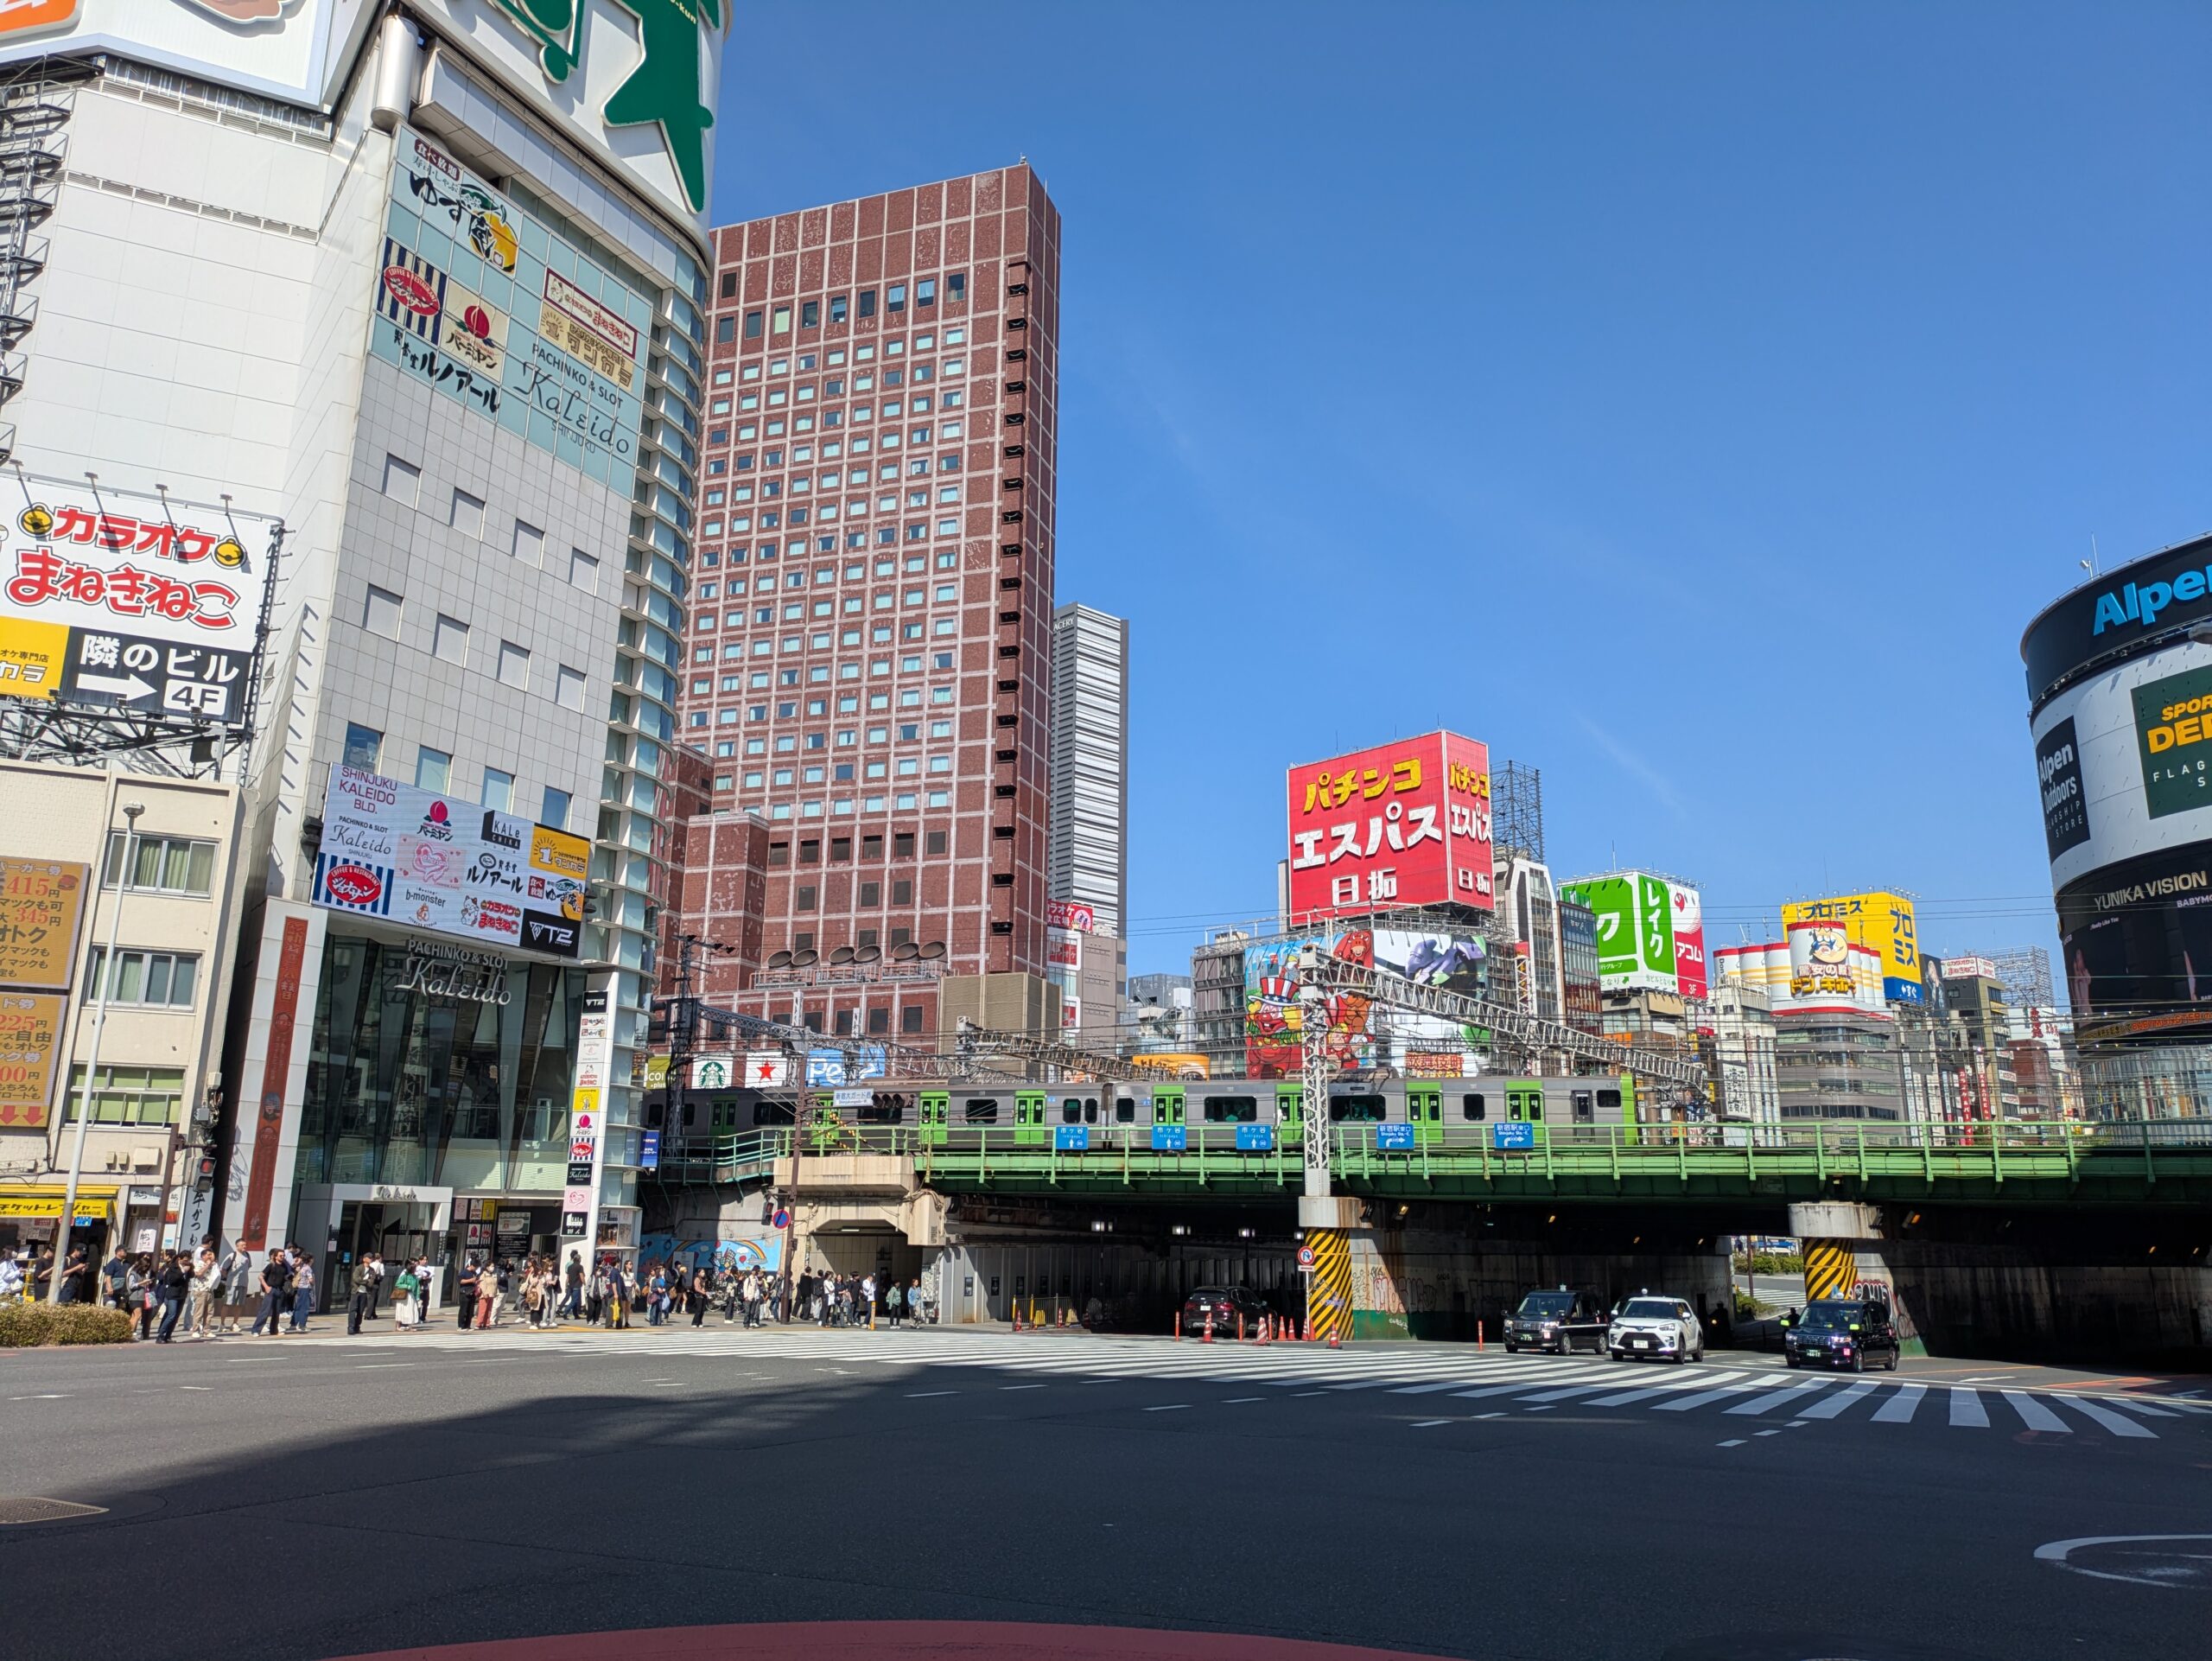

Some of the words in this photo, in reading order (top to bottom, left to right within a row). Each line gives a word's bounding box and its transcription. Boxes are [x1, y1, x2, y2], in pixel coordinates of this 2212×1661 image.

[416, 142, 460, 181] 食べ放題
[389, 267, 406, 277] COFFEE
[593, 309, 631, 347] まねきねこ
[446, 333, 499, 370] バーミヤン
[568, 332, 632, 388] ワンカラ
[419, 351, 500, 414] ルノアール
[532, 343, 587, 386] PACHINKO
[588, 381, 596, 393] &
[599, 385, 624, 409] SLOT
[551, 420, 596, 455] SHINJUKU
[50, 506, 218, 563] カラオケ
[8, 547, 238, 628] まねきねこ
[2093, 564, 2212, 636] Alpe
[80, 634, 240, 684] 隣のビル
[172, 685, 219, 710] 4F
[341, 767, 397, 792] SHINJUKU
[1450, 758, 1489, 799] パチンコ
[2039, 743, 2074, 787] Alpen
[339, 780, 396, 805] KALEIDO
[1303, 757, 1422, 813] パチンコ
[2044, 775, 2077, 815] Outdoors
[353, 799, 378, 814] BLD.
[2045, 800, 2081, 830] FLAGSHIP
[339, 816, 368, 829] PACHINKO
[416, 824, 454, 842] バーミヤン
[1293, 801, 1443, 869] エスパス
[1451, 802, 1491, 843] エスパス
[2055, 815, 2083, 838] STORE
[331, 866, 348, 877] COFFEE
[353, 866, 379, 887] RESTAURANT
[467, 865, 524, 894] ルノアール
[555, 856, 586, 874] ワンカラ
[1458, 866, 1491, 894] 日拓
[405, 889, 447, 908] b-monster
[1332, 867, 1397, 907] 日拓
[2094, 885, 2145, 912] YUNIKA
[2145, 870, 2209, 899] VISION
[478, 912, 519, 935] まねきねこ
[1646, 882, 1664, 958] レイク
[1804, 900, 1864, 920] プロミス
[1890, 909, 1914, 939] プロ
[408, 939, 470, 962] PACHINKO
[471, 952, 480, 964] &
[482, 954, 509, 970] SLOT
[1675, 941, 1703, 963] アコム
[1893, 938, 1916, 968] ミス
[1688, 984, 1697, 995] 3F
